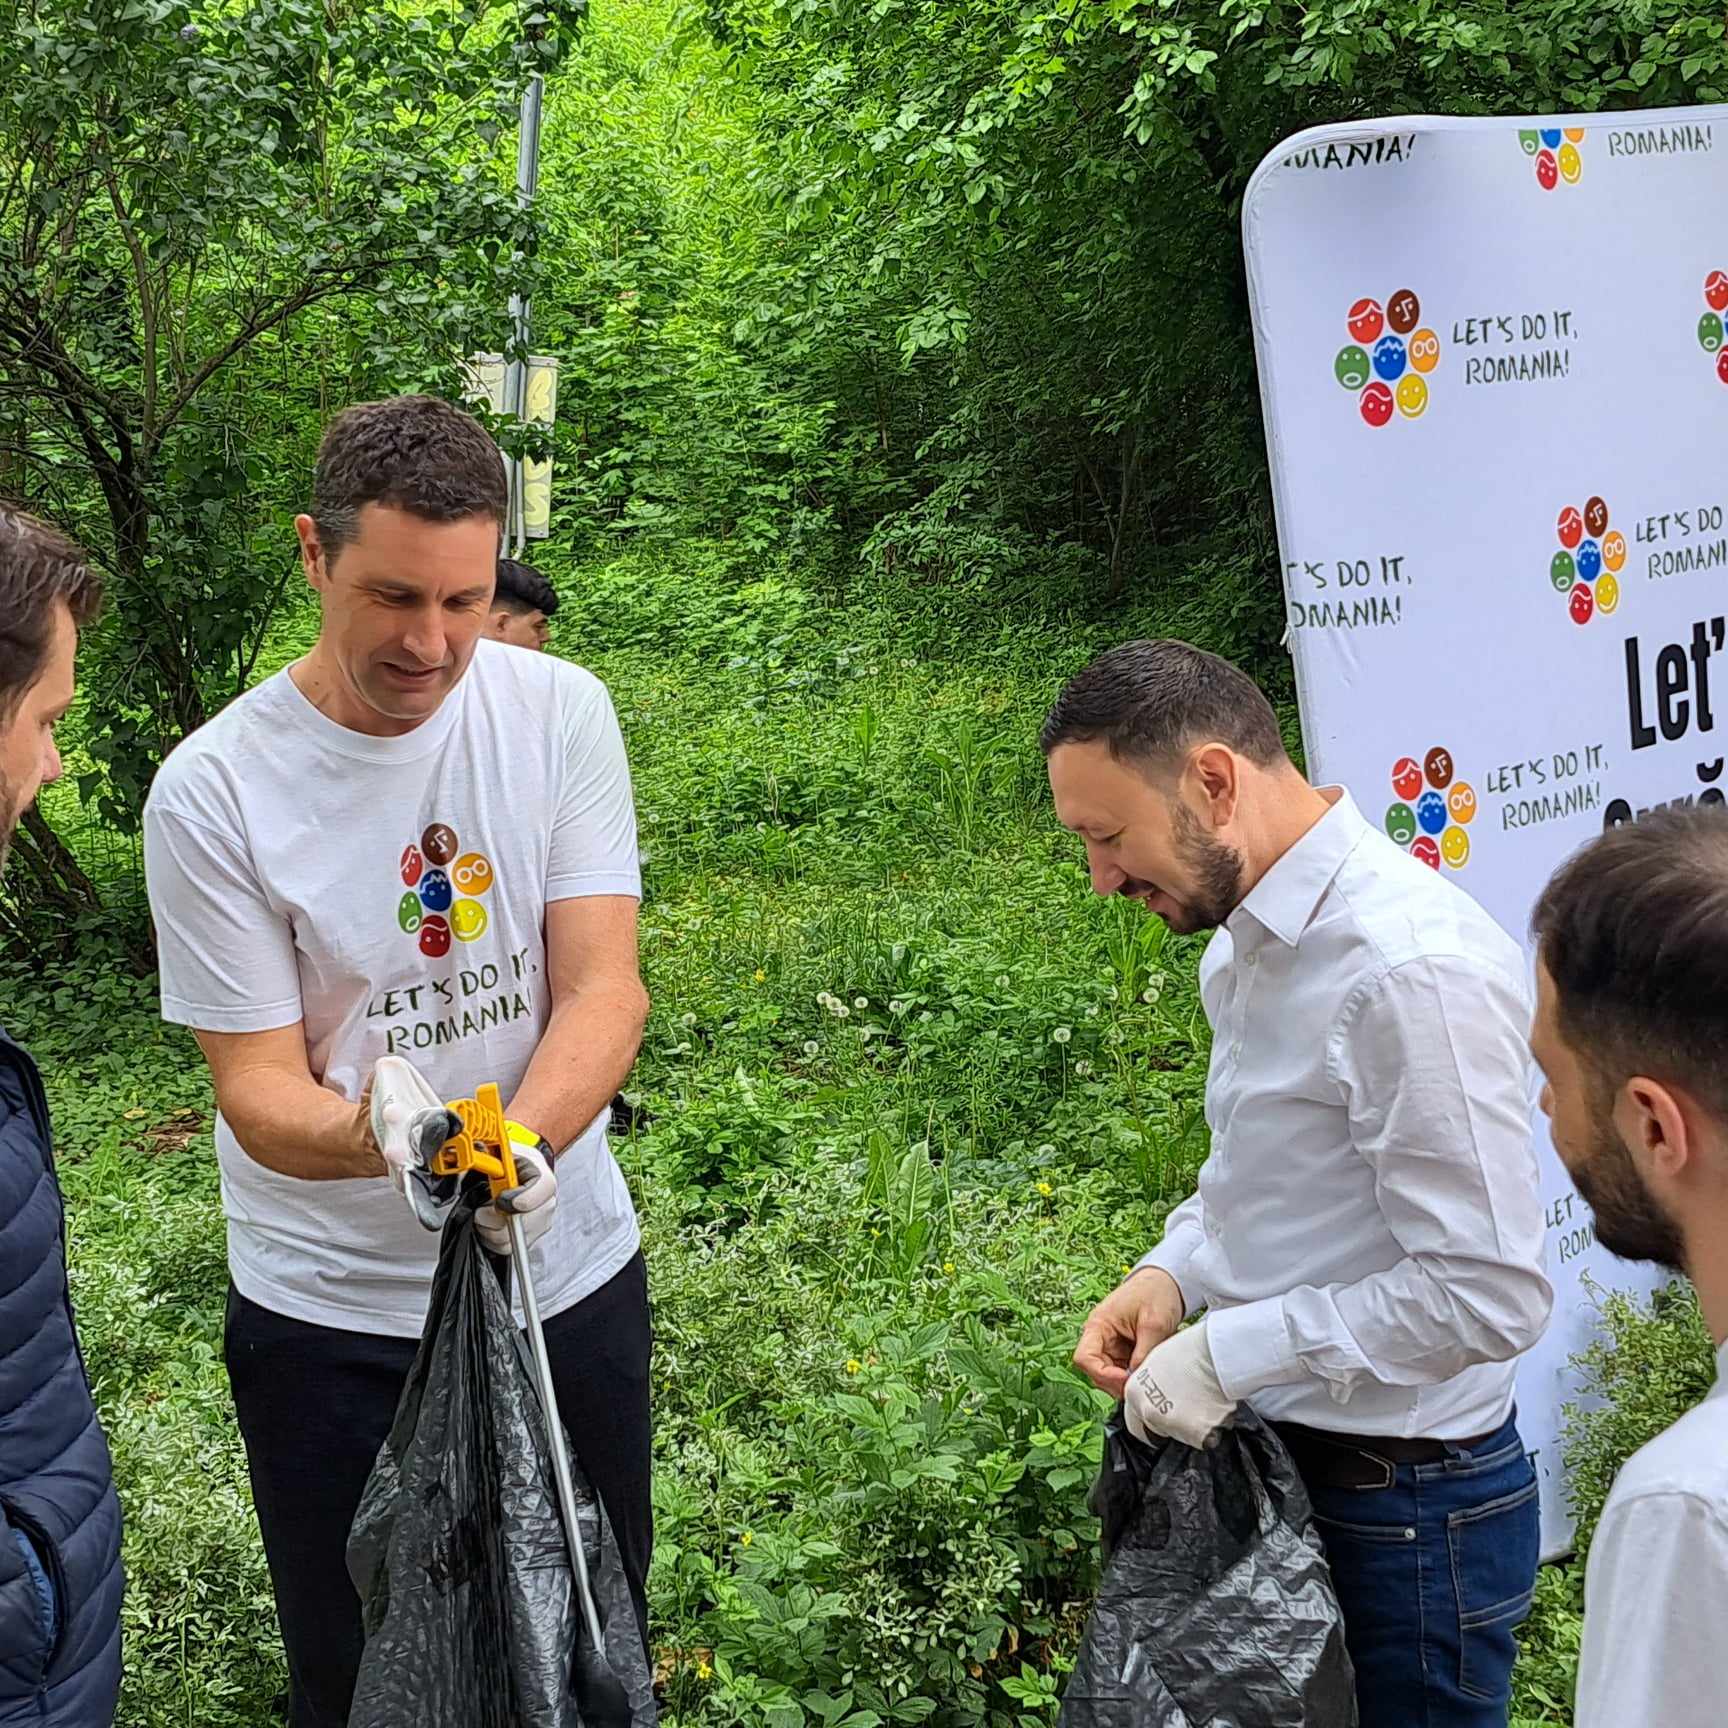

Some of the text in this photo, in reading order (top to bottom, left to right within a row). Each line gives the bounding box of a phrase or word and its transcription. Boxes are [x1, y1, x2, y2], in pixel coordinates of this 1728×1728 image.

[1607, 125, 1712, 156] ROMANIA!
[1453, 311, 1578, 345] LET'S DO IT,
[1466, 349, 1569, 385] ROMANIA!
[1636, 506, 1722, 543] LET'S DO
[1286, 556, 1412, 588] T'S DO IT,
[1648, 539, 1727, 579] ROMANI
[1290, 595, 1401, 629] OMANIA!
[1624, 616, 1725, 750] Let'
[1487, 744, 1609, 793] LET'S DO IT,
[1502, 781, 1600, 830] ROMANIA!
[367, 978, 453, 1018] LET'S
[459, 964, 499, 996] DO
[1545, 1192, 1589, 1229] LET
[1559, 1221, 1596, 1264] ROM
